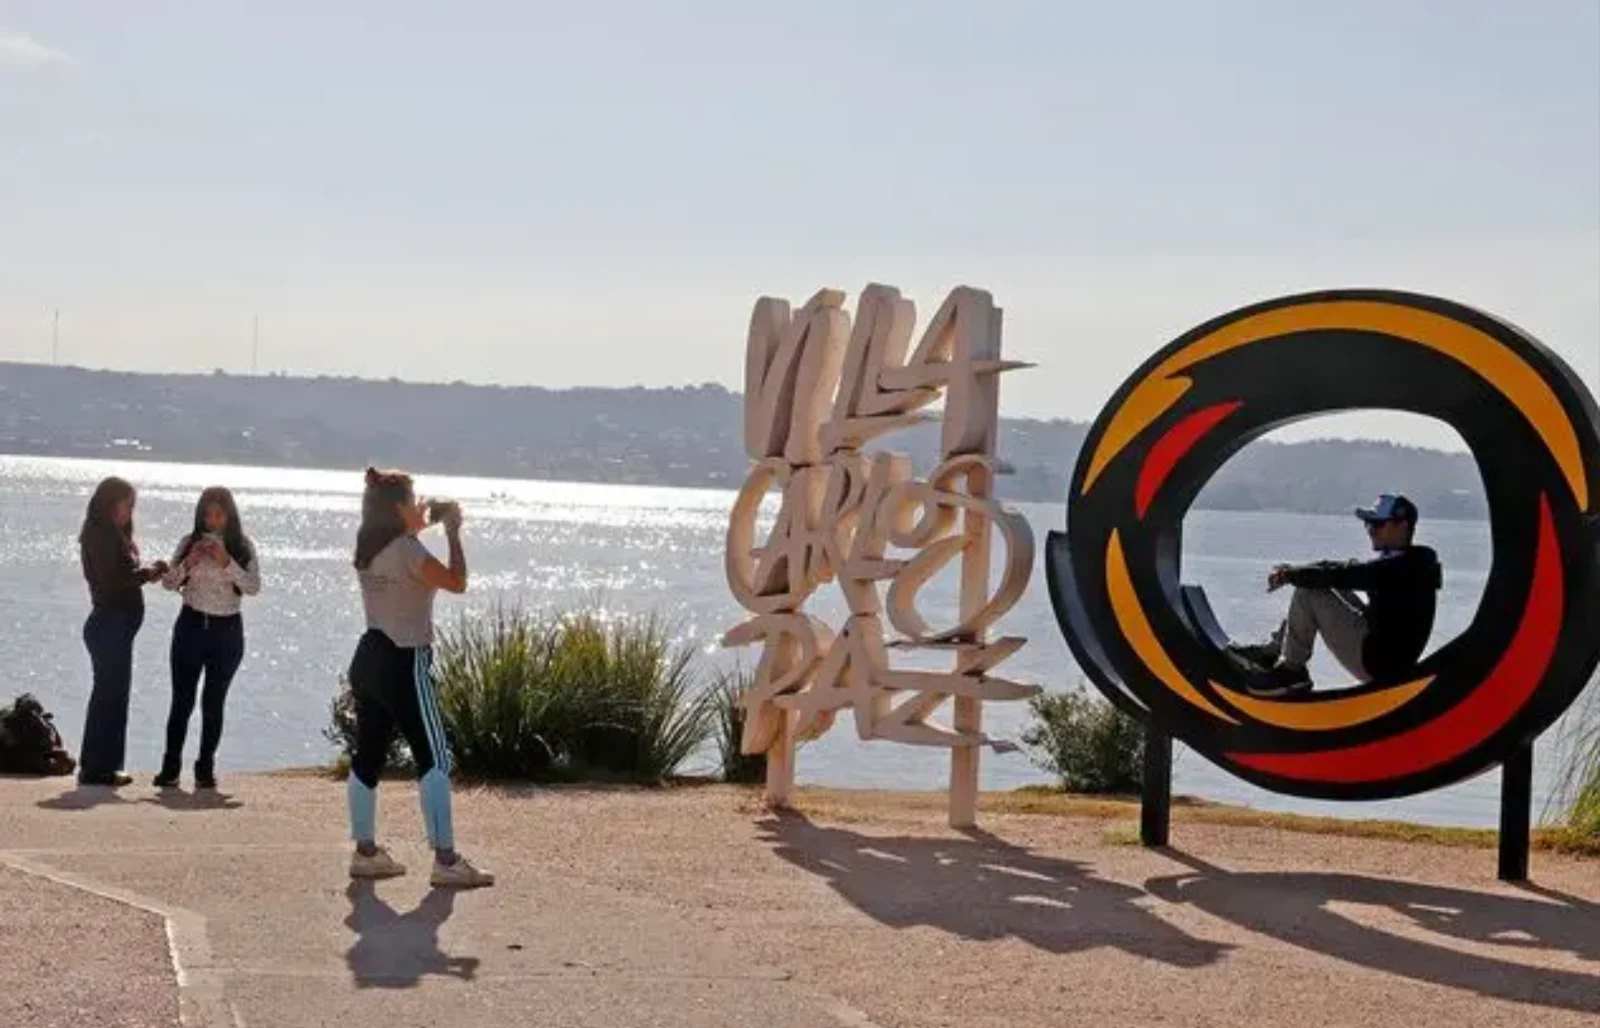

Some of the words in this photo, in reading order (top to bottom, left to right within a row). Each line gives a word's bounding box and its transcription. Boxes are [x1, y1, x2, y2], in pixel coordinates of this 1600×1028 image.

[744, 282, 1037, 464] VILLA
[726, 453, 1035, 642] CARLOS
[722, 611, 1042, 754] PAZ
